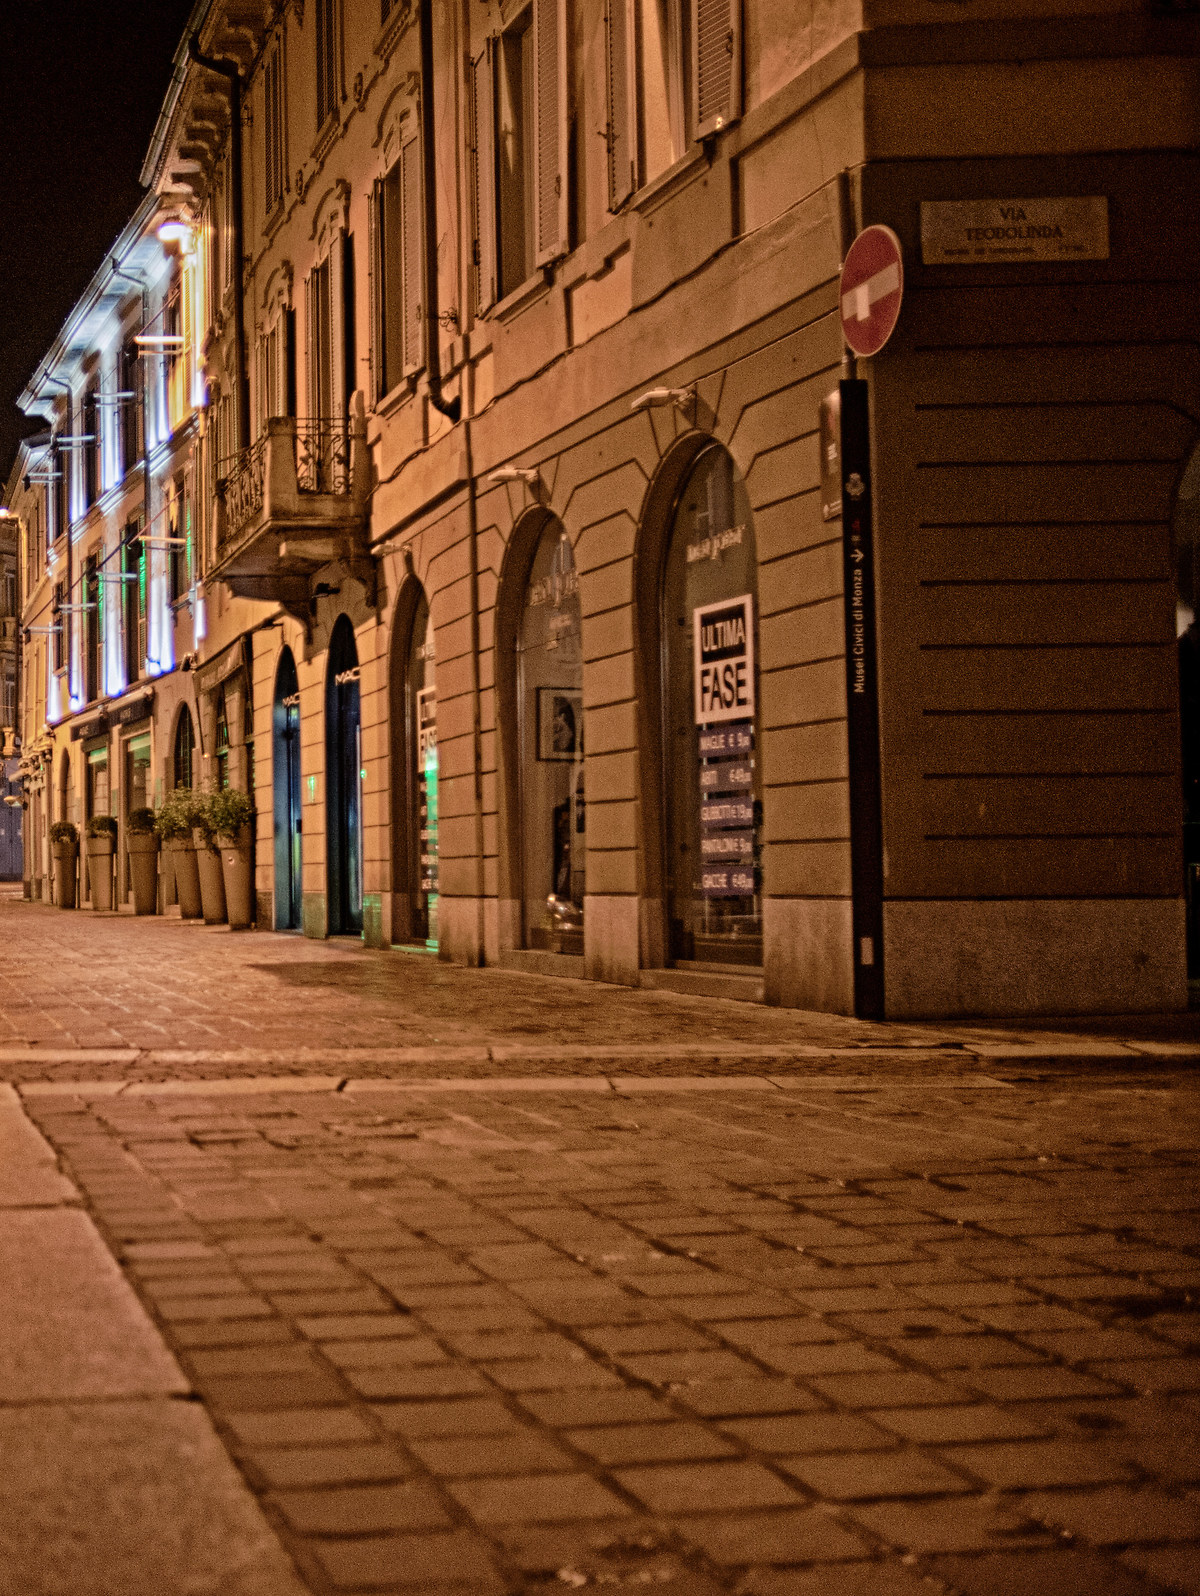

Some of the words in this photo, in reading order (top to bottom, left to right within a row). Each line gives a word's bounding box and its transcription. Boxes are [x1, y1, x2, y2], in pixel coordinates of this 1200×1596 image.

[1000, 207, 1027, 221] VIA
[964, 225, 1064, 241] TEODOLINDA
[853, 568, 863, 607] Monza
[852, 610, 863, 621] di
[701, 617, 746, 652] ULTIMA
[853, 623, 864, 655] Civici
[701, 660, 747, 712] FASE
[853, 657, 865, 693] Musei
